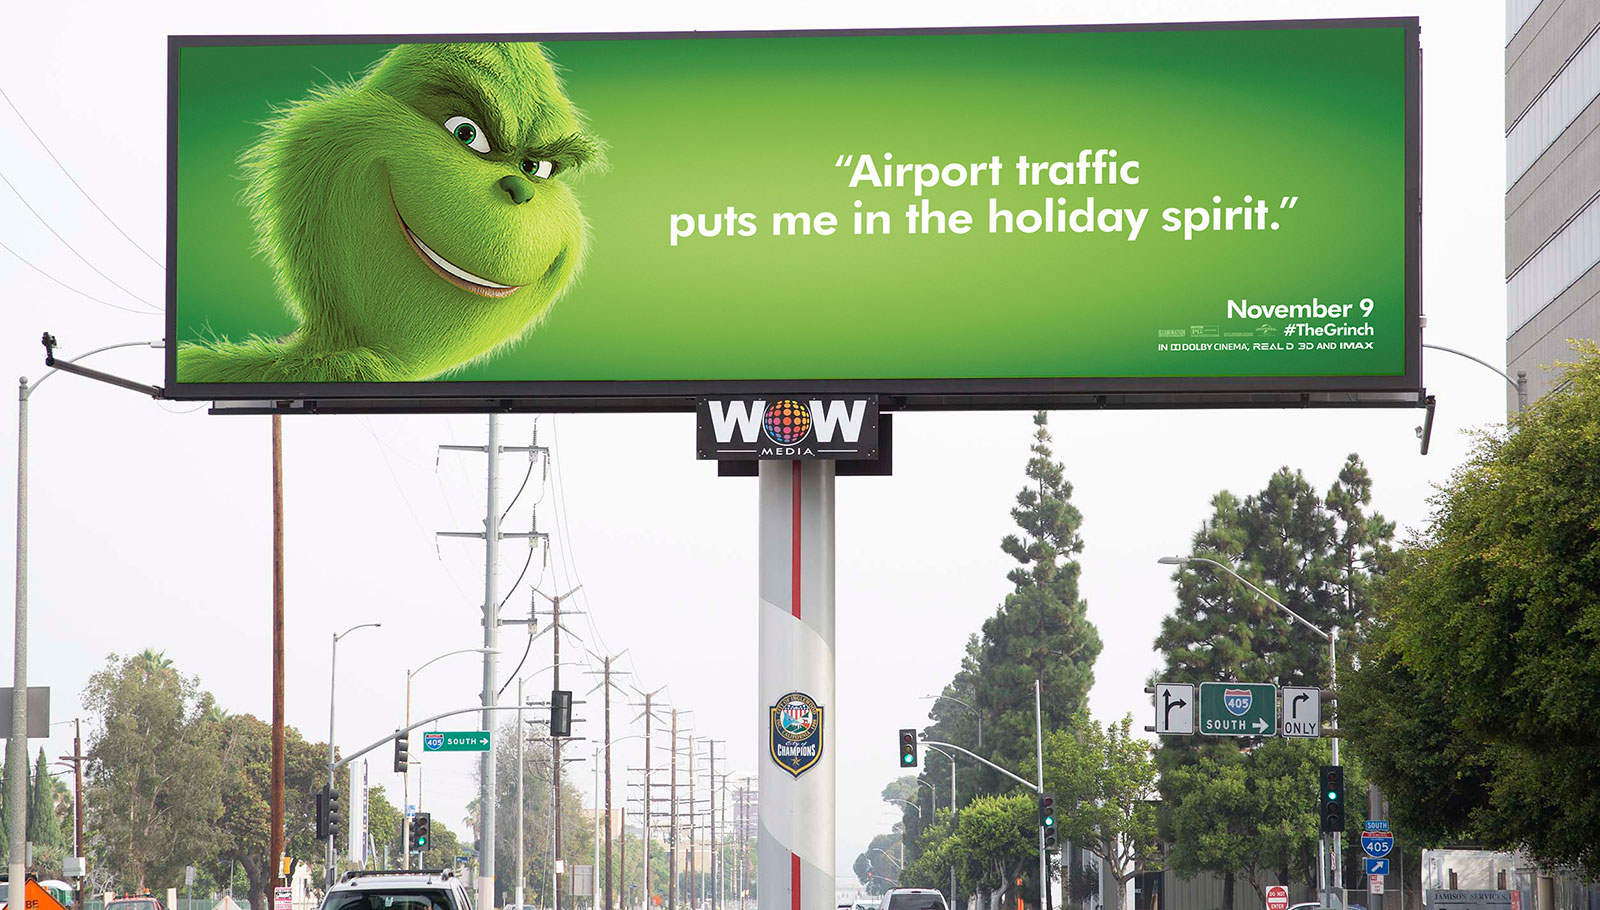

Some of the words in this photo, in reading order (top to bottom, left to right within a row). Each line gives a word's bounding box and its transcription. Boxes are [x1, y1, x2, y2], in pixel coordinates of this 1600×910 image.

[835, 152, 1002, 195] “Airport
[1016, 149, 1139, 187] traffic
[670, 206, 757, 246] puts
[772, 211, 838, 236] me
[853, 200, 891, 235] in
[906, 199, 972, 235] the
[989, 197, 1148, 241] holiday
[1162, 195, 1299, 240] spirit.”
[1227, 298, 1353, 320] November
[1360, 298, 1375, 318] 9
[1283, 323, 1375, 337] #TheGrinch
[1340, 342, 1374, 350] IMAX
[708, 400, 867, 446] WOW
[761, 447, 814, 456] MEDIA
[1227, 699, 1249, 709] 405
[1206, 720, 1247, 730] SOUTH
[1285, 722, 1316, 735] ONLY
[777, 744, 816, 757] CHAMPIONS
[1366, 842, 1389, 852] 405
[1434, 893, 1467, 901] JAMISON
[25, 900, 39, 909] BE
